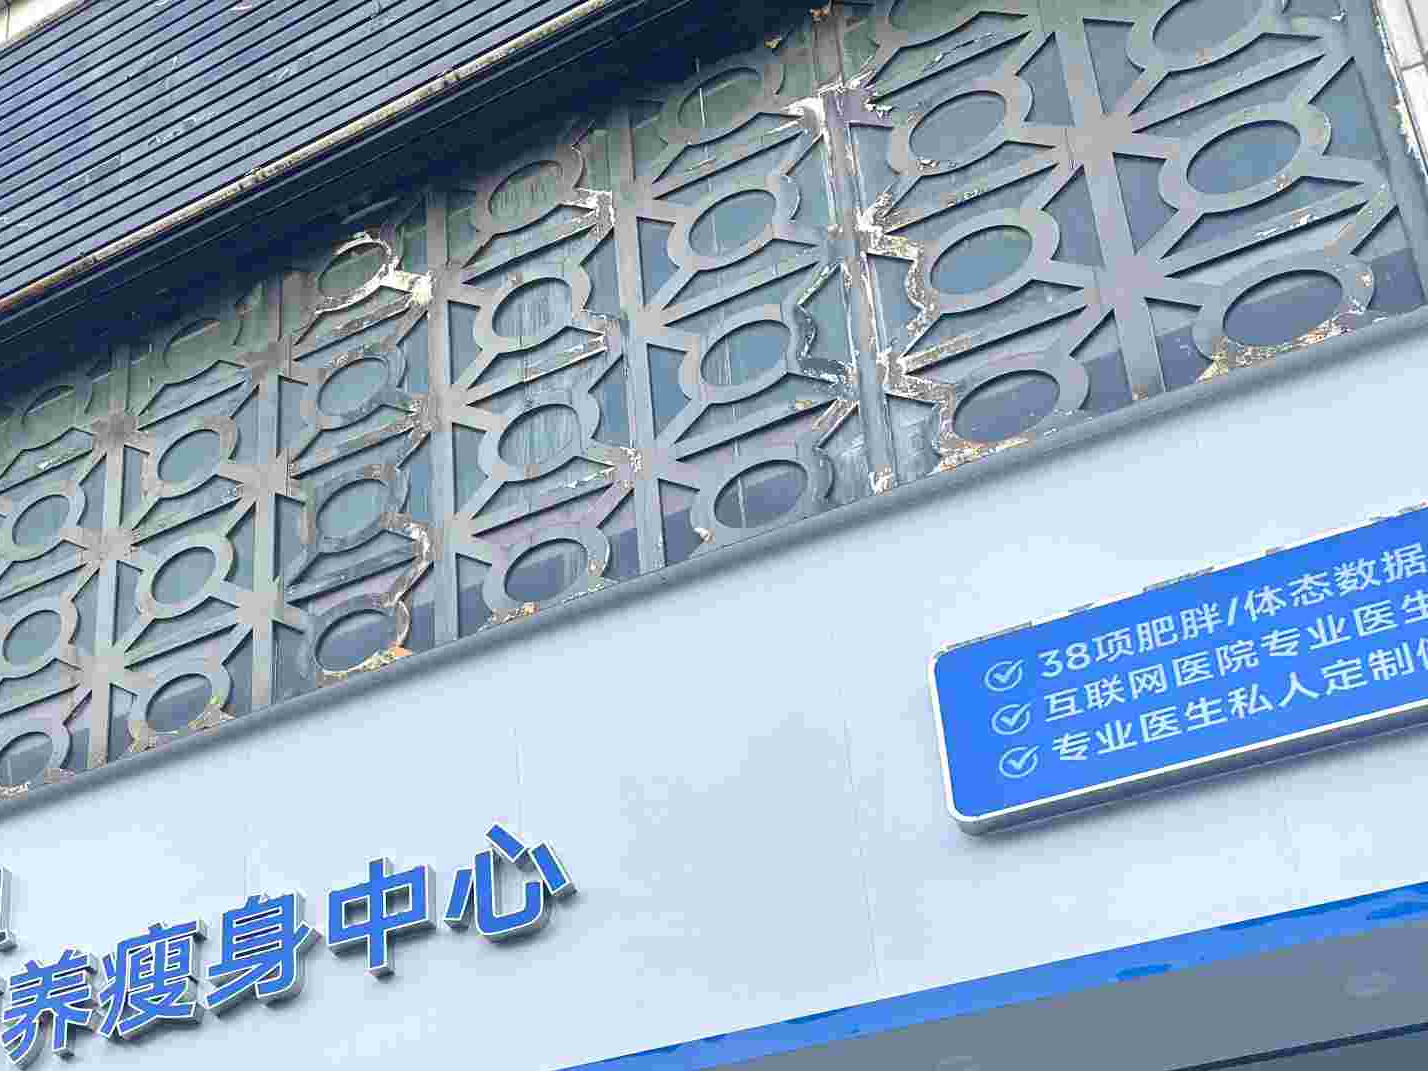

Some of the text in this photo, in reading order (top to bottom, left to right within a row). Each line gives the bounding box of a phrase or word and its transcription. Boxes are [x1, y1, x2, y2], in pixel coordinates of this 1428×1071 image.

[1037, 541, 1428, 679] 38项肥胖/体态数据
[1051, 637, 1428, 761] 专业医生私人定制
